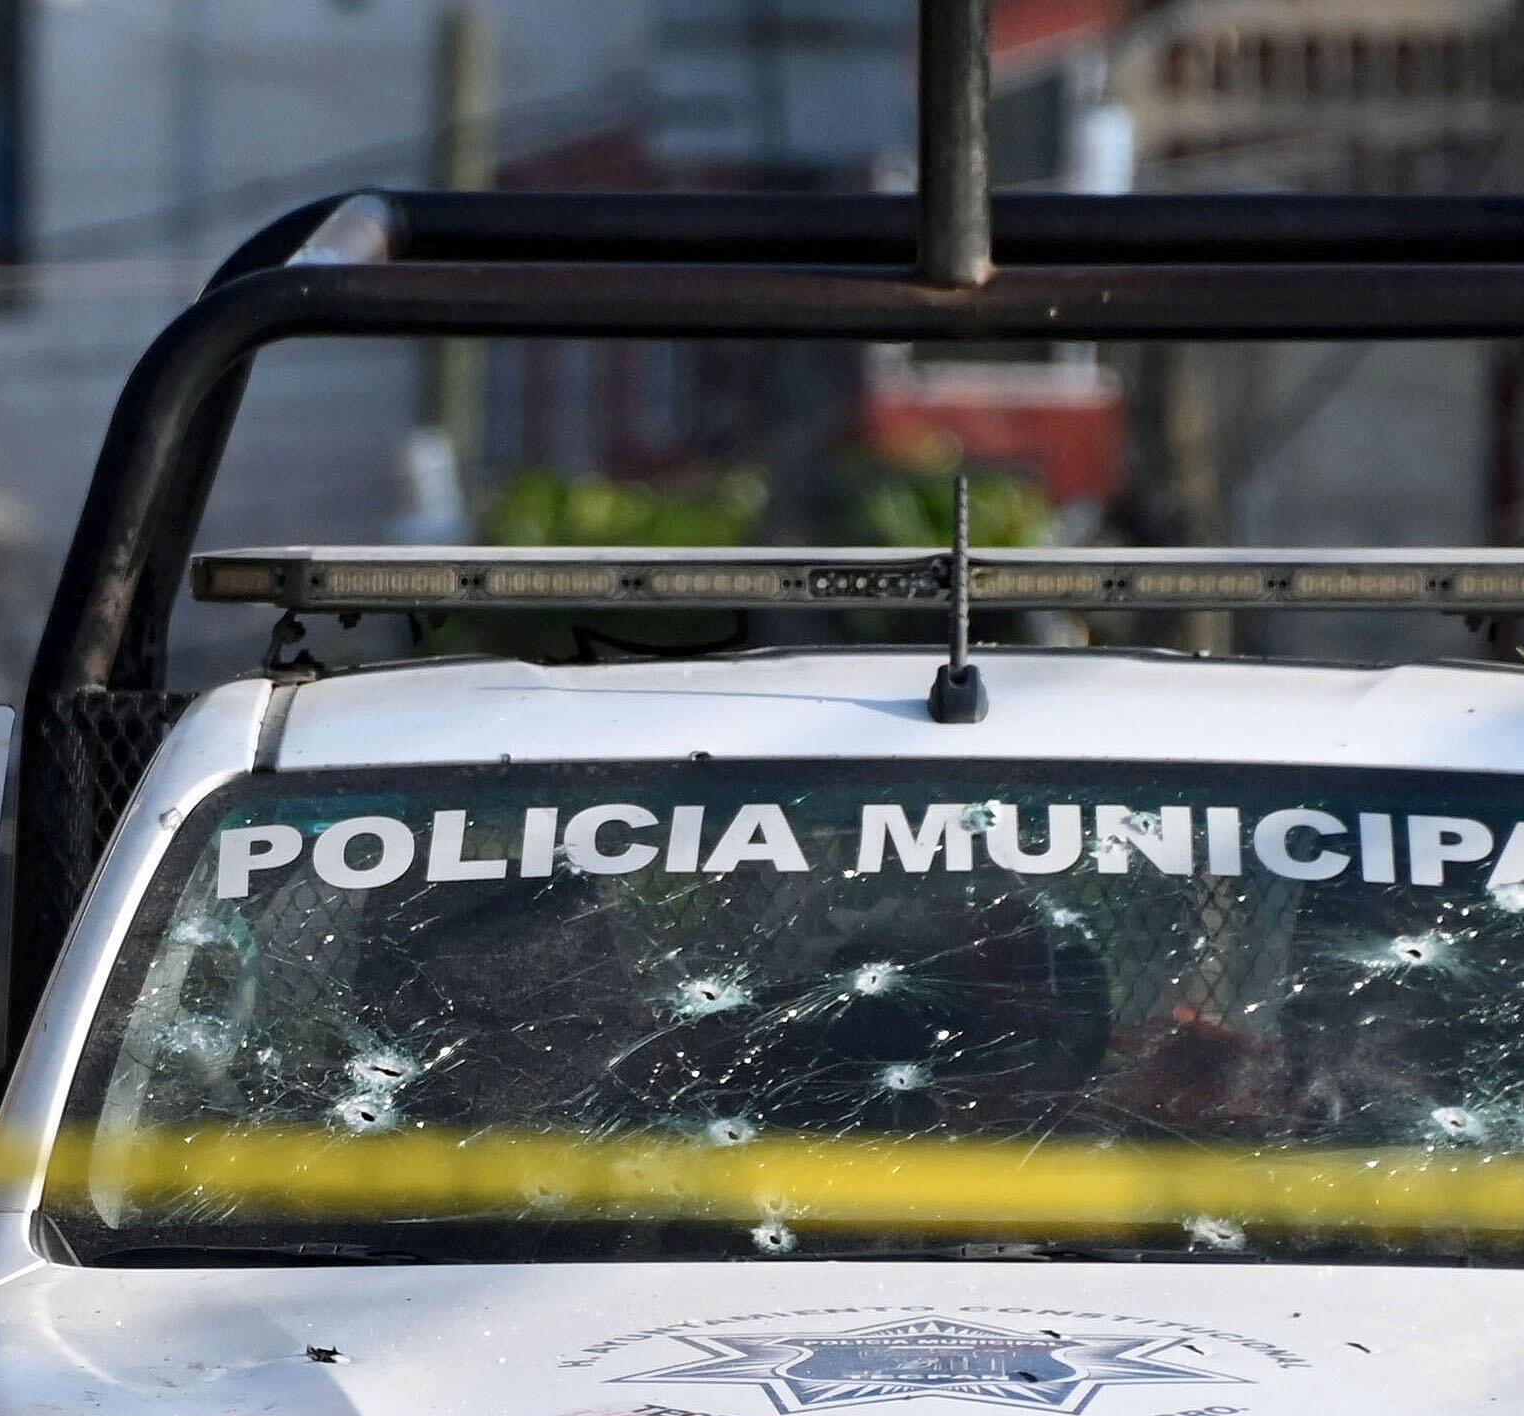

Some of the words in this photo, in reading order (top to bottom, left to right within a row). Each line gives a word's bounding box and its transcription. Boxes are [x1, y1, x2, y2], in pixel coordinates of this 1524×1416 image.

[214, 803, 810, 900] POLICIA
[803, 1339, 908, 1347] POLICIA
[917, 1338, 1064, 1347] MUNICIPAL
[959, 1306, 1312, 1369] CONSTITUCIONAL
